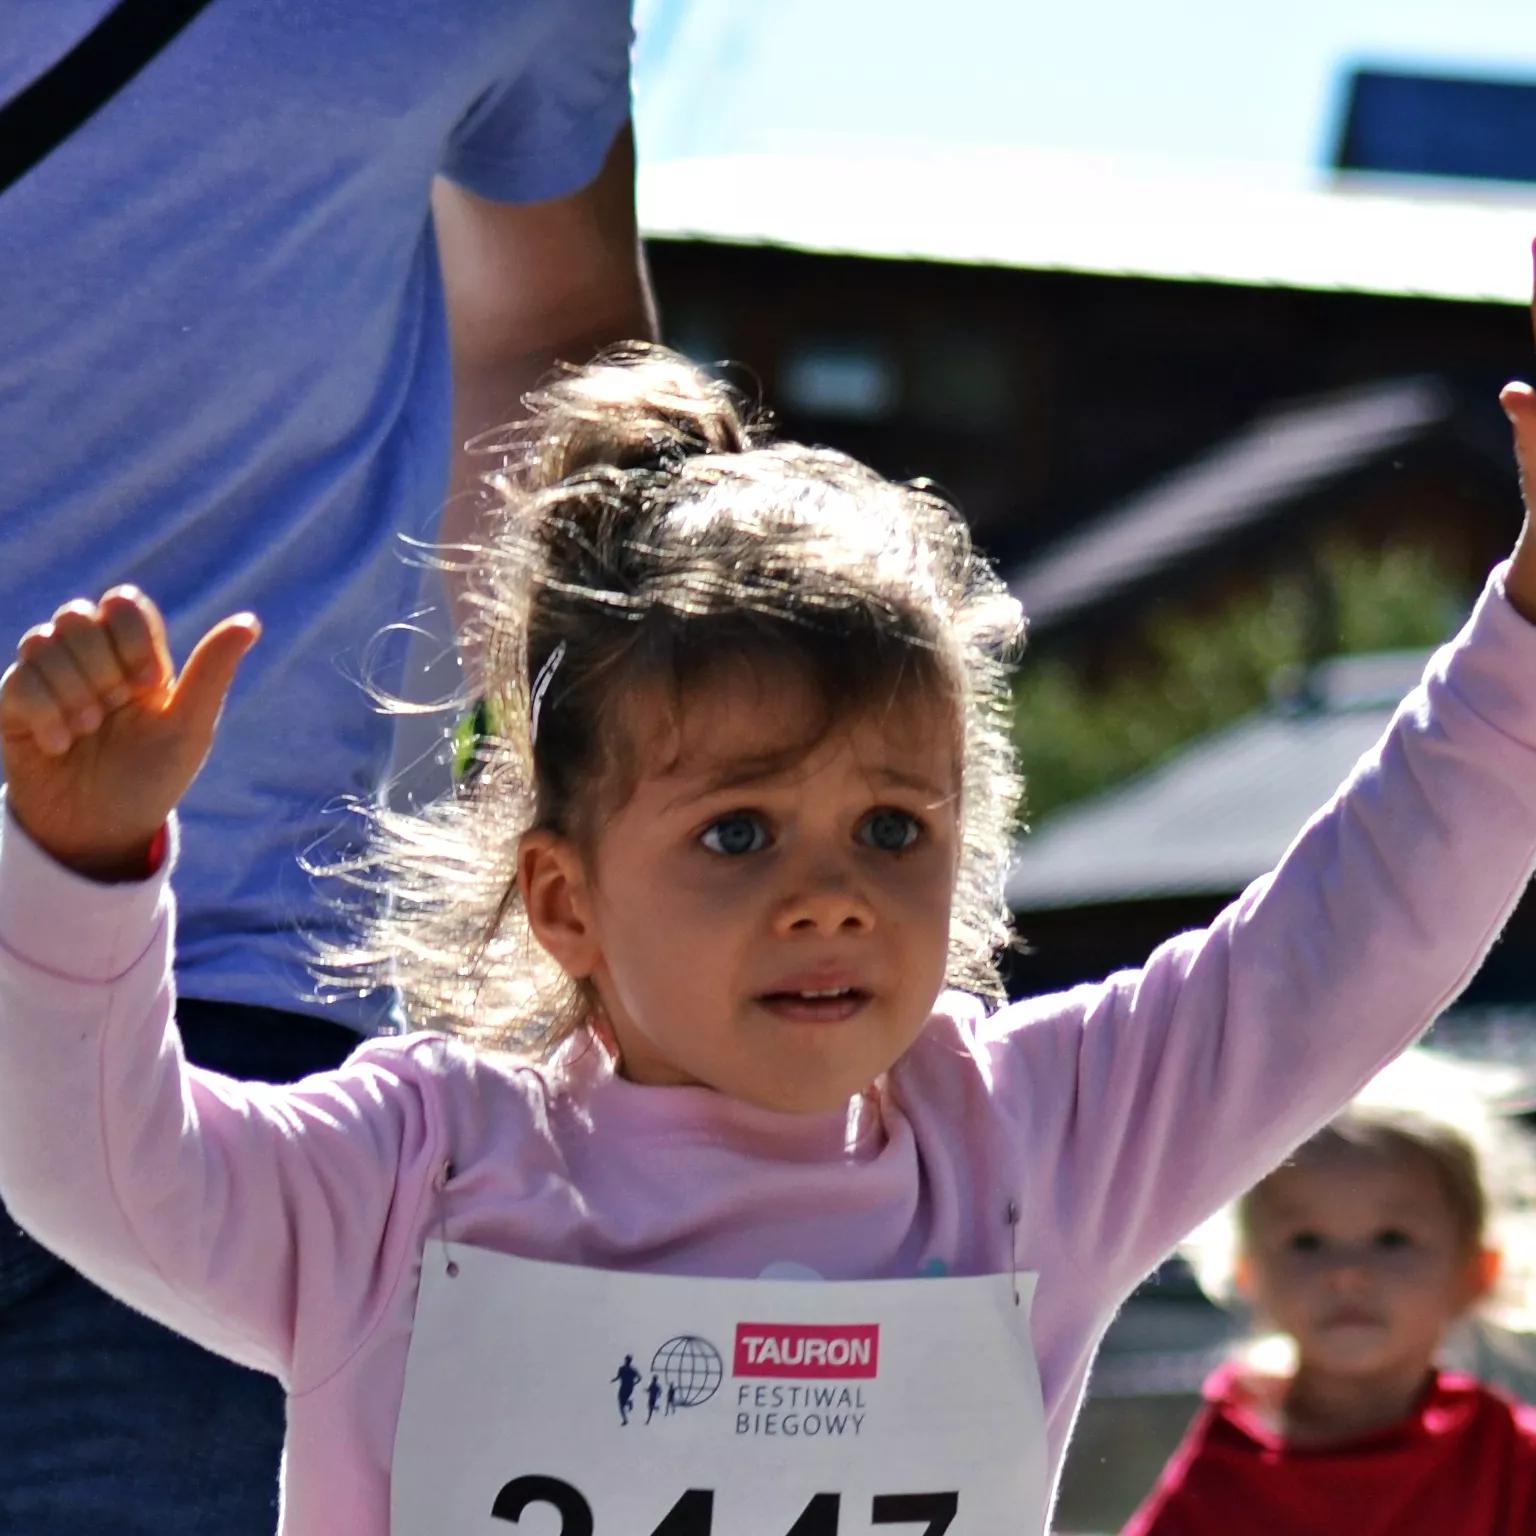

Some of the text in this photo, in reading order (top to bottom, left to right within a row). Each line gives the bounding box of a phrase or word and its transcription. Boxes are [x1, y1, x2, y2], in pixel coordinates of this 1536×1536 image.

[741, 1336, 872, 1366] TAURON
[737, 1385, 867, 1408] FESTIWAL
[735, 1412, 866, 1436] BIEGOWY
